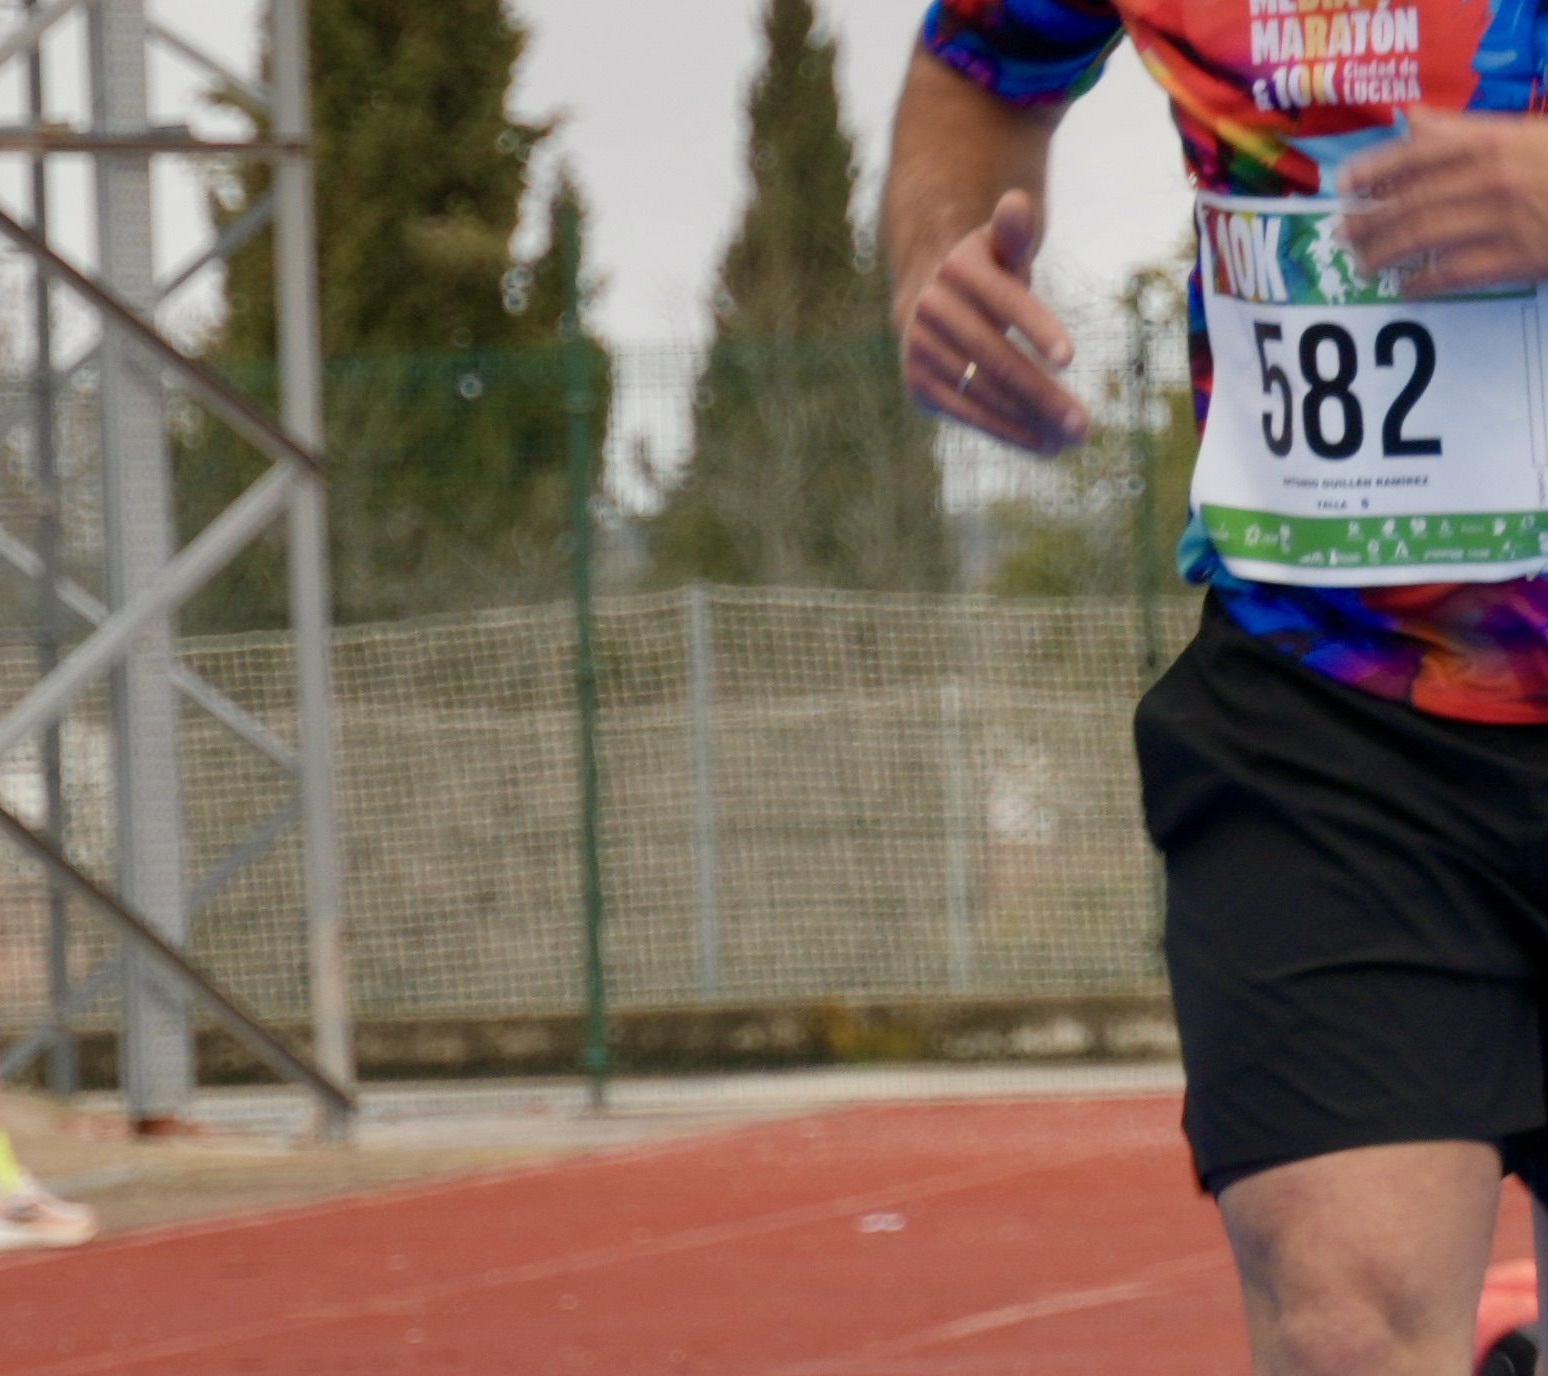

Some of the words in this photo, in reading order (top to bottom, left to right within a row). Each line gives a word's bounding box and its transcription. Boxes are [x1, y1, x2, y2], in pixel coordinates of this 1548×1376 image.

[1272, 62, 1339, 110] 10K
[1343, 76, 1422, 104] LUCENA
[1215, 216, 1289, 304] 10K
[1254, 318, 1443, 461] 582
